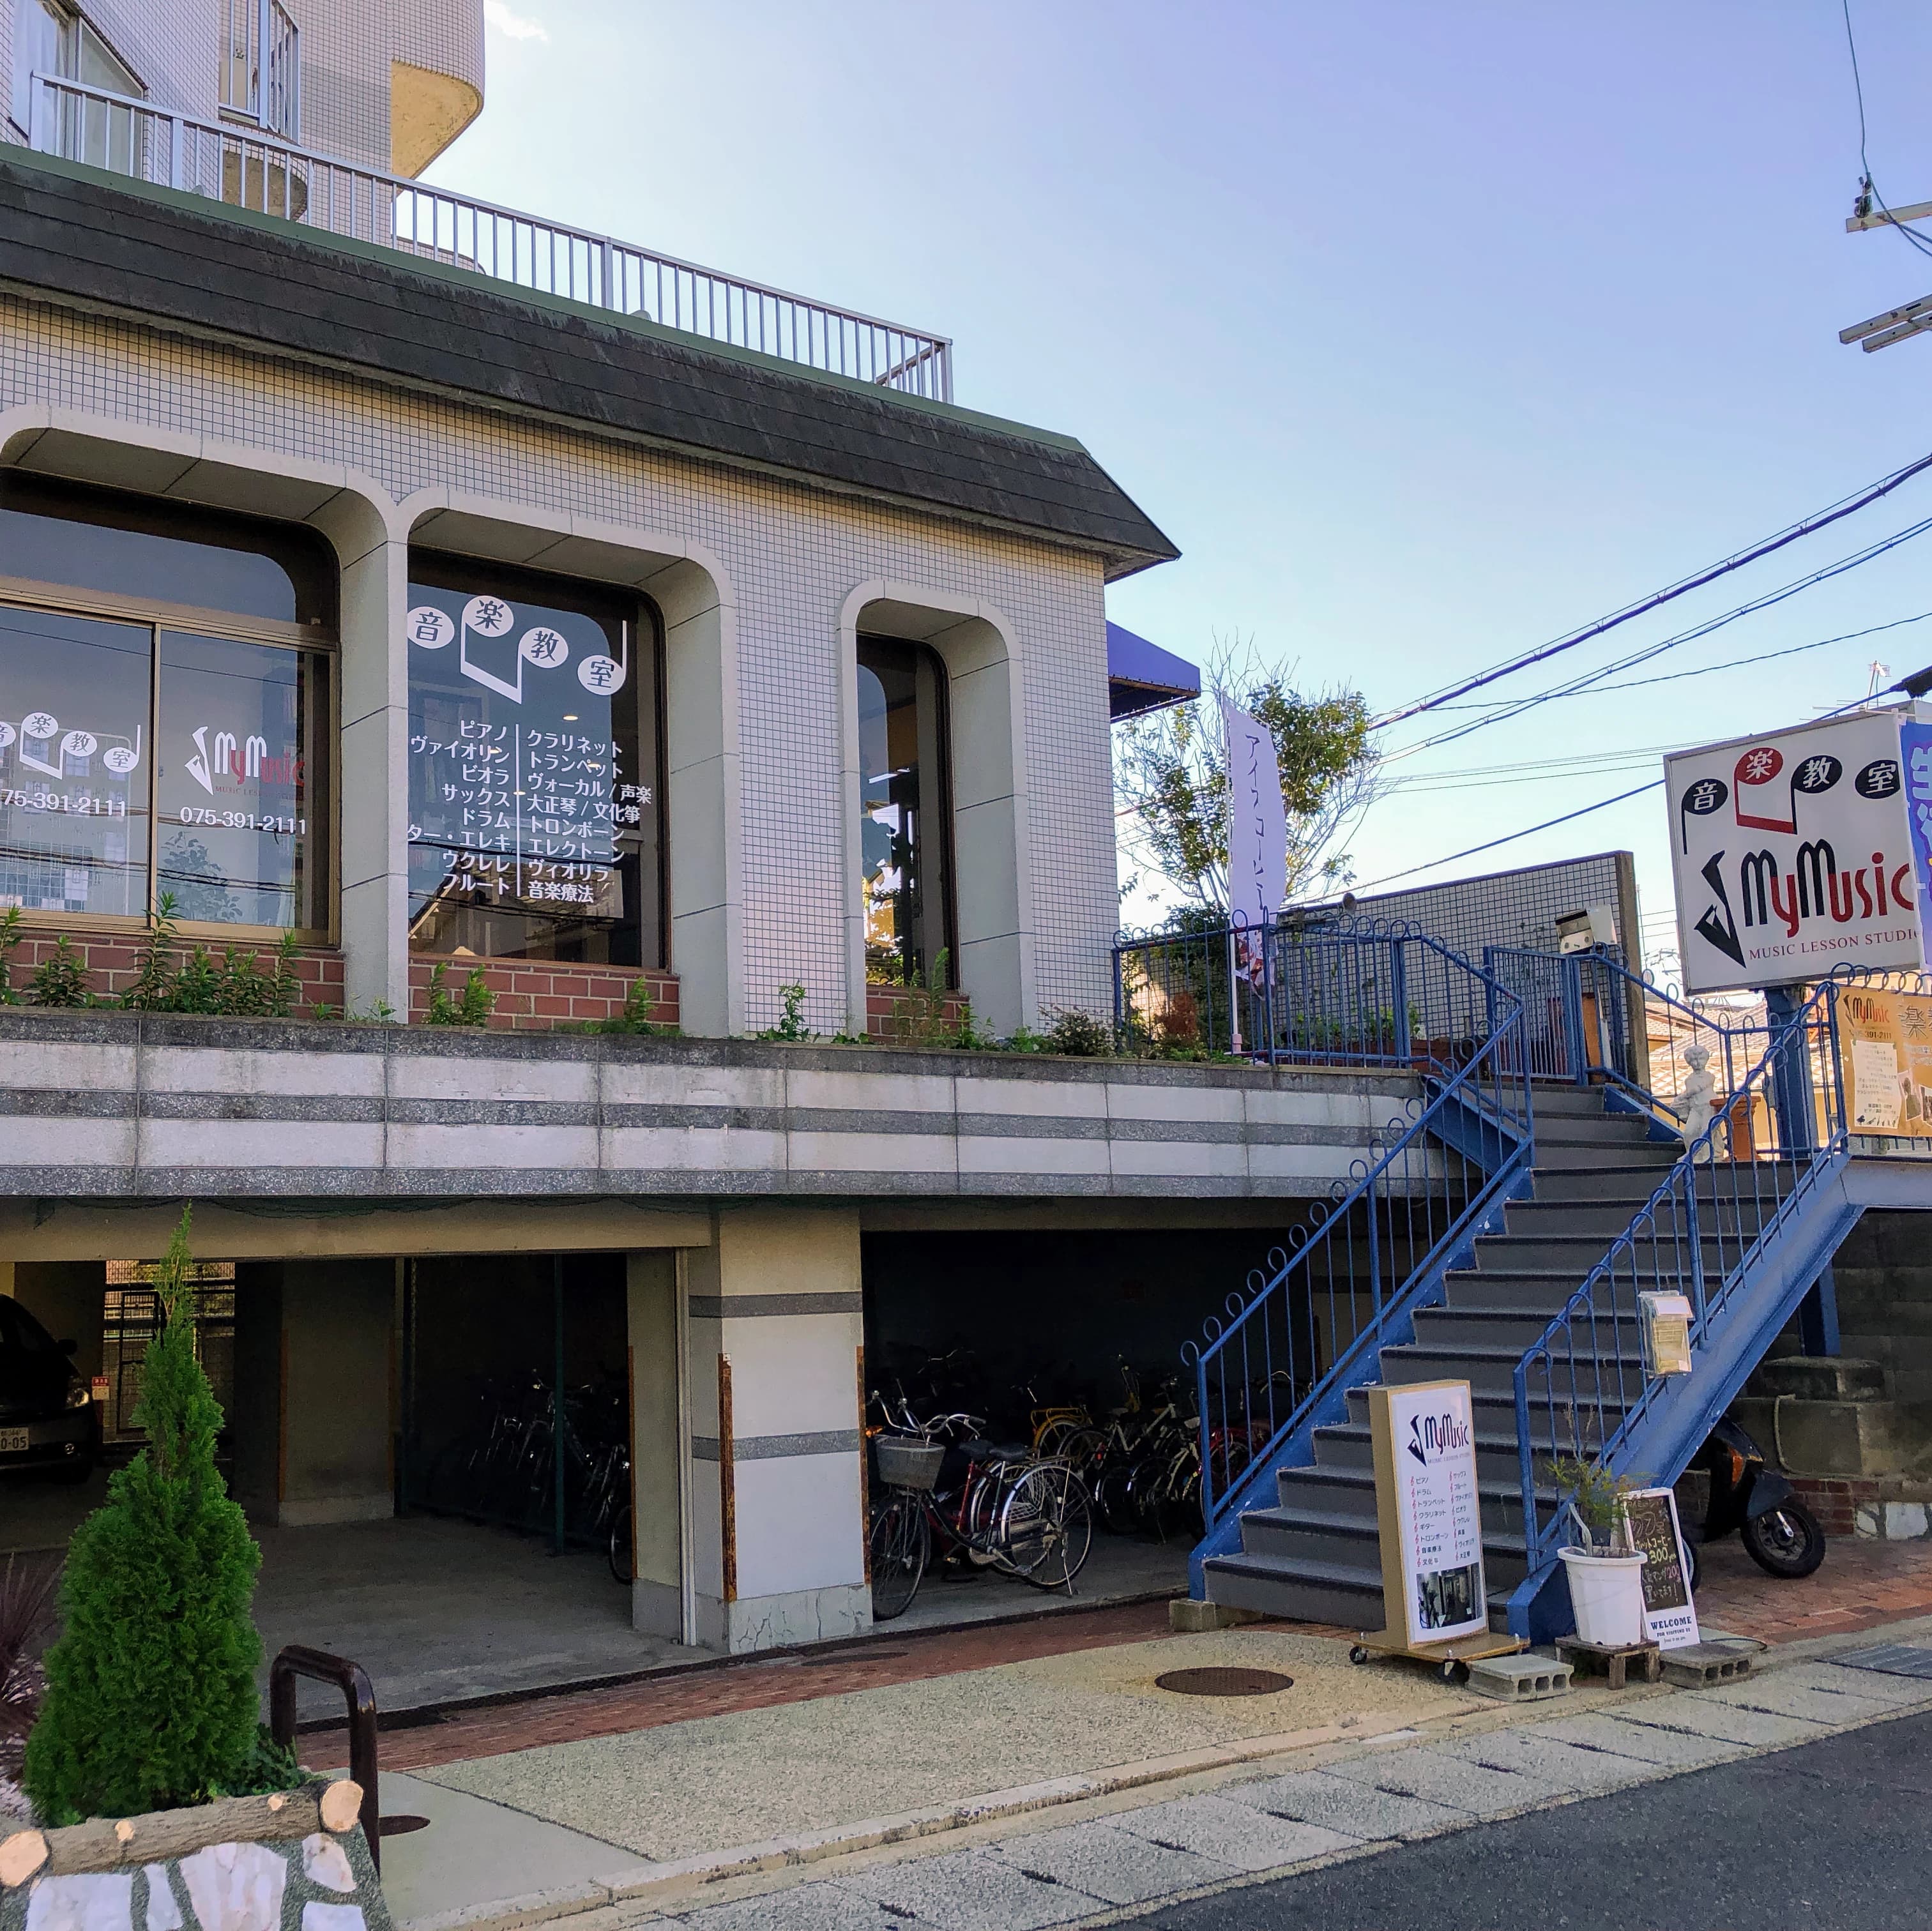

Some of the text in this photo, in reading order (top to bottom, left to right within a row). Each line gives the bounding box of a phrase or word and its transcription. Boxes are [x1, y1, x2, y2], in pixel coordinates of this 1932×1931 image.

[415, 600, 615, 689] 音楽教室
[460, 720, 507, 741] ピアノ
[411, 735, 510, 763] ヴァイオリン
[528, 729, 623, 758] クラリネット
[463, 764, 509, 785] ビオラ
[531, 751, 623, 779] トランペット
[1692, 750, 1900, 812] 音楽教室
[441, 783, 510, 807] サックス
[180, 806, 306, 835] 075-391-2111
[464, 808, 510, 829] ドラム
[531, 815, 624, 841] トロンボーン
[1245, 734, 1265, 911] アイスコーヒー
[443, 849, 510, 872] ウクレレ
[528, 838, 624, 862] エレクトーン
[529, 858, 609, 882] ヴィオリラ
[443, 873, 510, 895] フルート
[528, 880, 594, 903] 音楽療法
[1749, 928, 1919, 960] MUSIC LESSON STUDI
[1418, 1498, 1445, 1508] トランペット
[1419, 1510, 1446, 1519] クラリネット
[1648, 1547, 1668, 1564] 300
[1650, 1616, 1692, 1630] WELCOME
